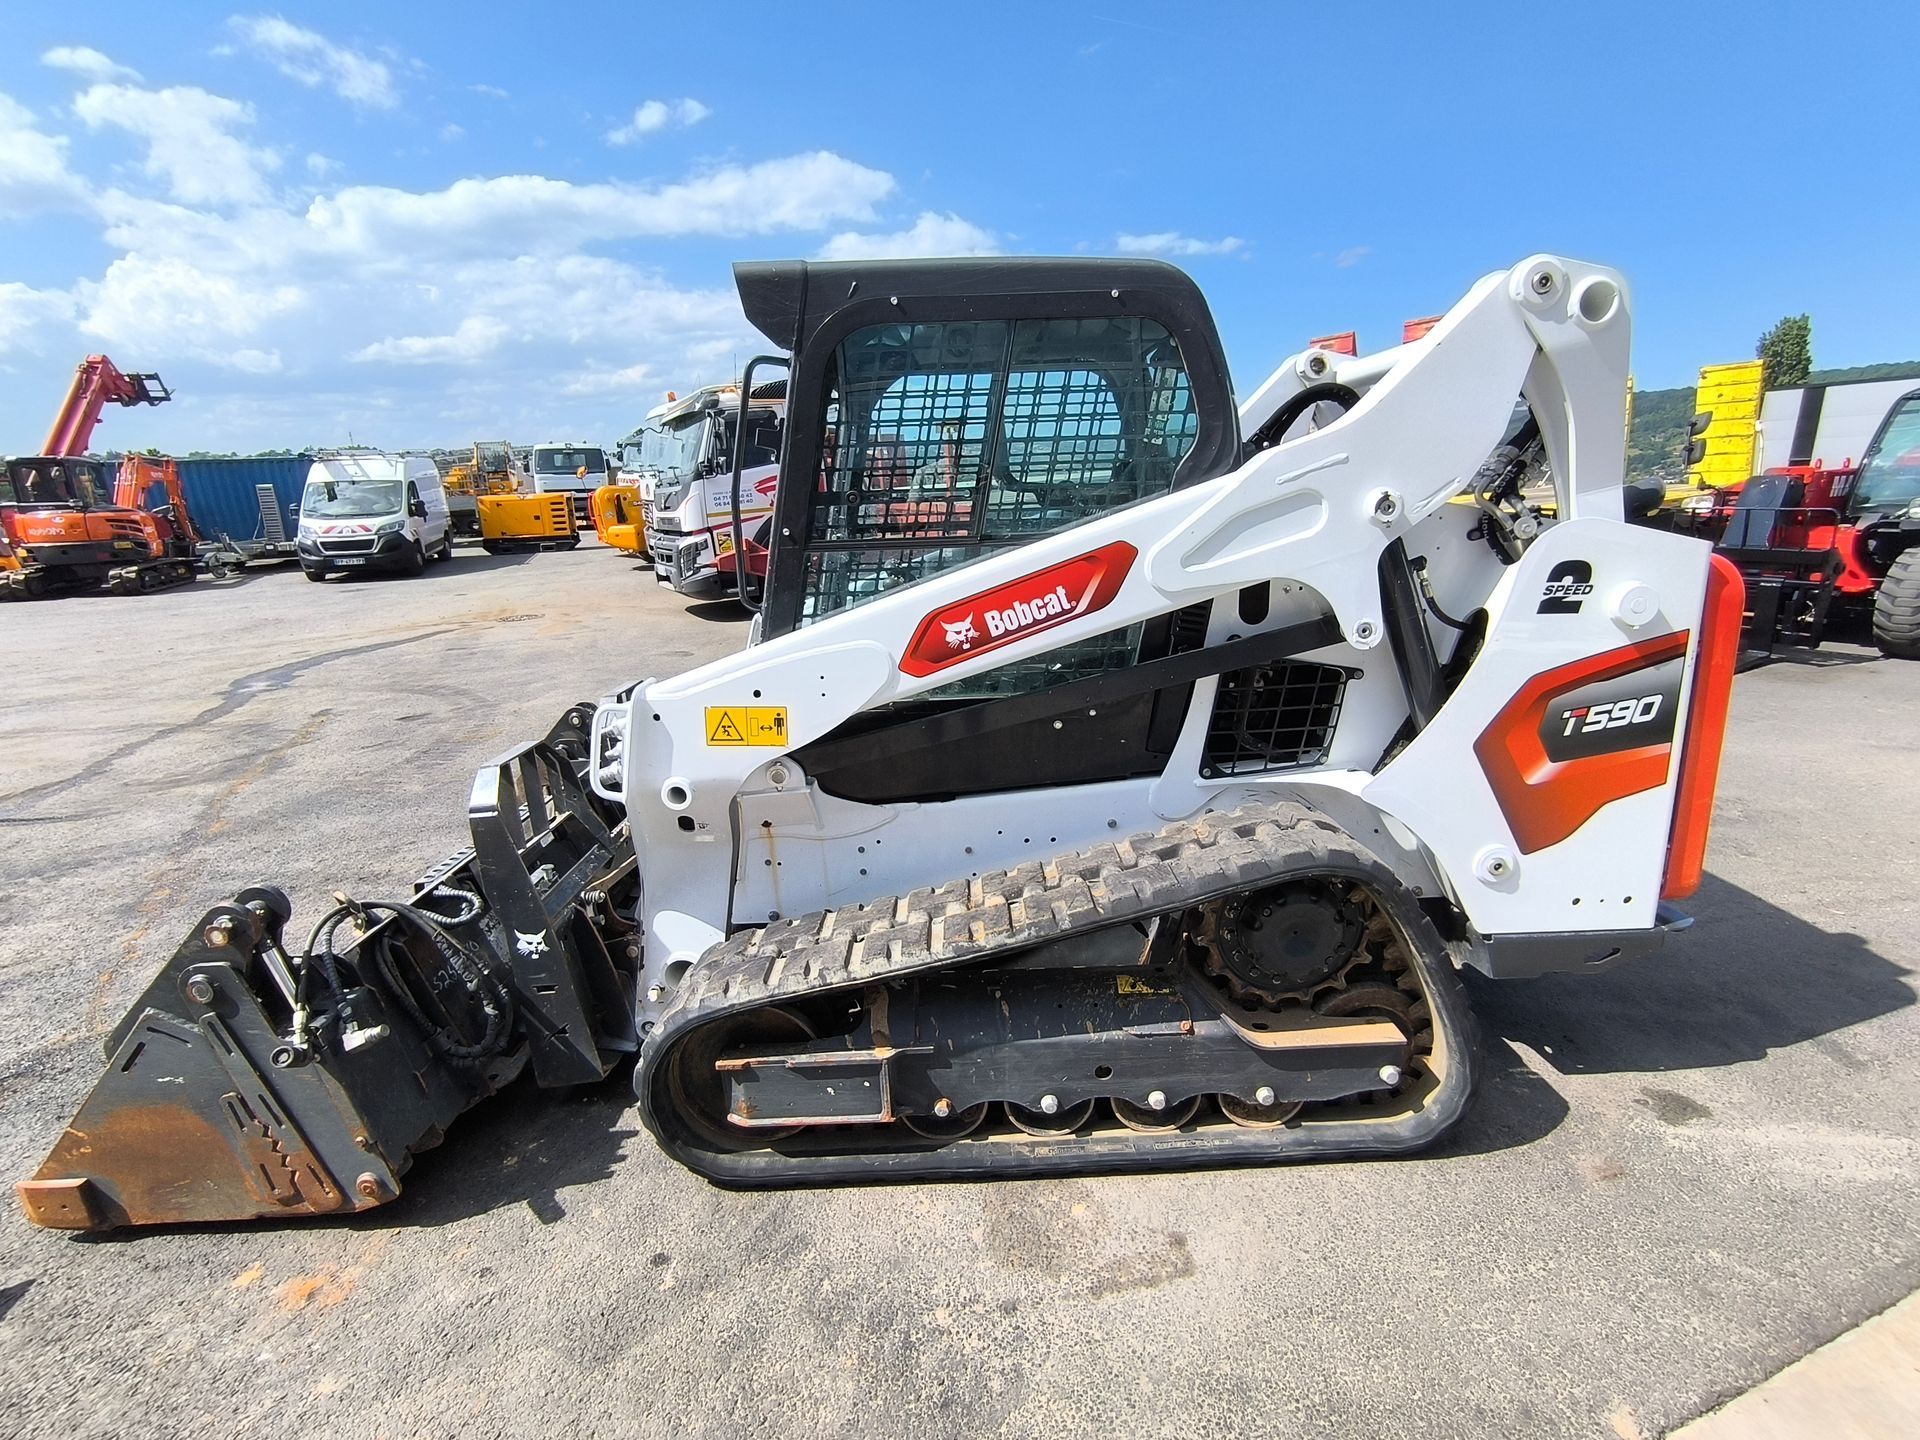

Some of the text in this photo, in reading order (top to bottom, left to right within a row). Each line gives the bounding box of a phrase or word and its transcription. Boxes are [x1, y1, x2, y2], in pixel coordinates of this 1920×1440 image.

[1536, 559, 1592, 614] 2
[1542, 584, 1594, 597] SPEED
[983, 585, 1072, 638] Bobcat
[1560, 693, 1664, 737] T590
